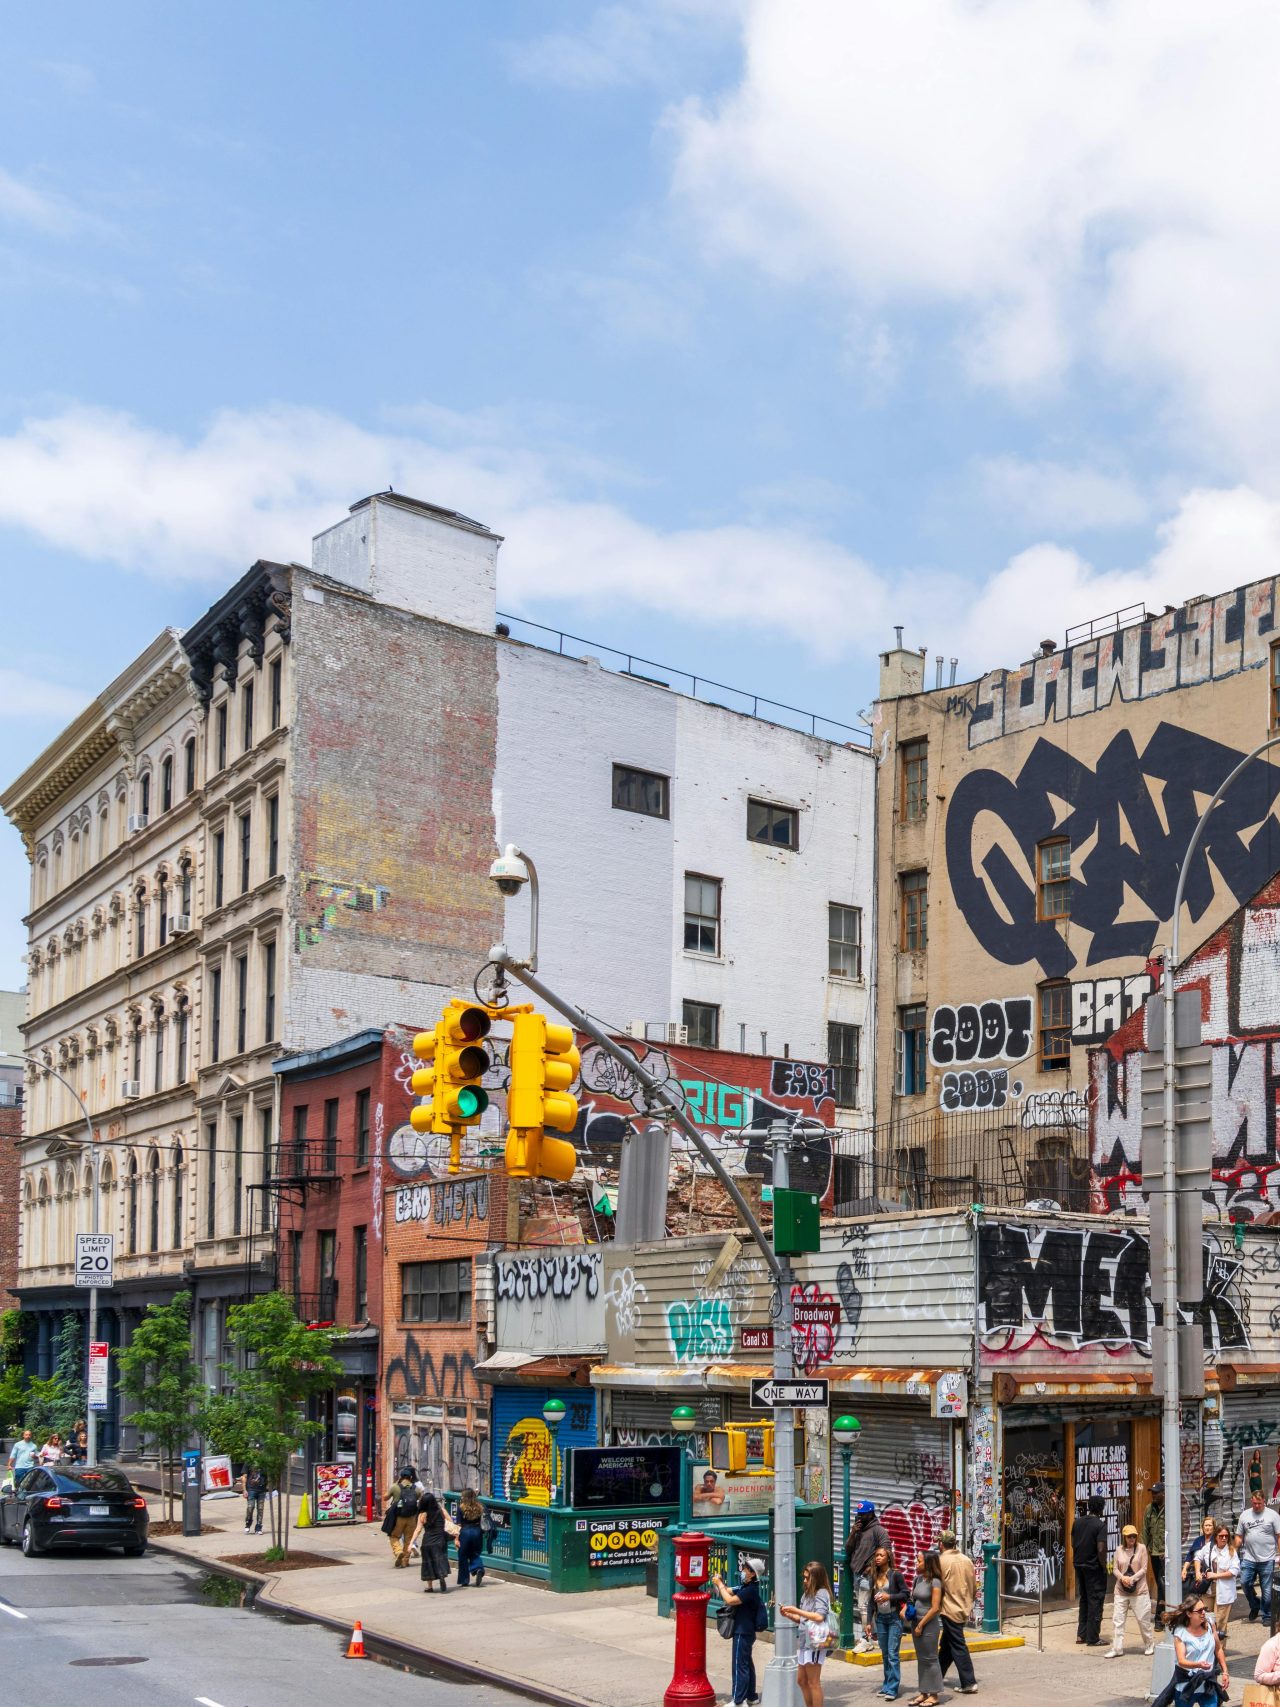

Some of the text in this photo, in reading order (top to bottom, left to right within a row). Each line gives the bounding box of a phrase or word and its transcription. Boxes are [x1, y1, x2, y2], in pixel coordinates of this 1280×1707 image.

[79, 1237, 110, 1245] SPEED
[82, 1245, 107, 1253] LIMIT
[80, 1256, 108, 1270] 20
[794, 1307, 834, 1323] Broadway
[742, 1332, 769, 1346] Canal St
[763, 1387, 819, 1399] ONE WAY
[1078, 1445, 1126, 1464] MY WIFE SAYS
[189, 1457, 196, 1466] P
[1076, 1465, 1084, 1482] IF
[1089, 1464, 1099, 1481] GO
[1101, 1462, 1128, 1480] FISHING
[728, 1484, 775, 1493] PHOENICIA
[1075, 1480, 1130, 1500] ONE MORE TIME
[590, 1520, 663, 1532] Canal St Station
[643, 1533, 655, 1544] W
